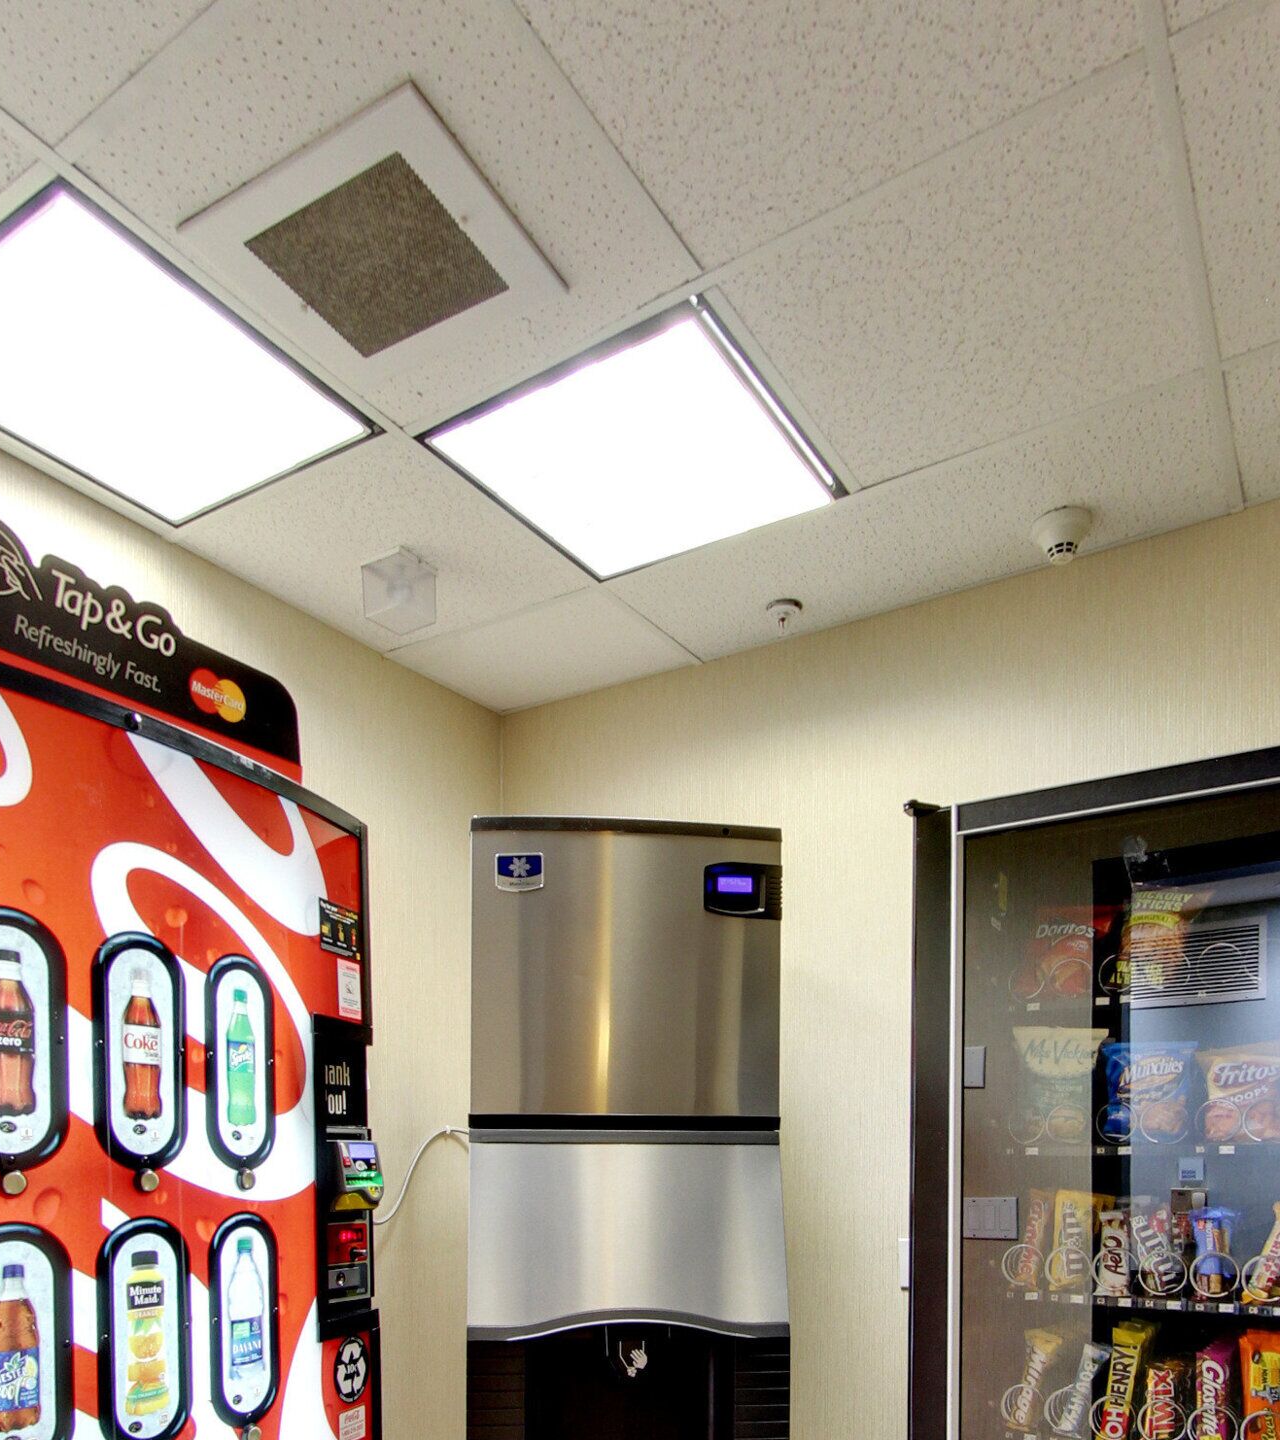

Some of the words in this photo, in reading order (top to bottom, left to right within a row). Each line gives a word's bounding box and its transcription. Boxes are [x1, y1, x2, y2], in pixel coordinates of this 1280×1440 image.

[50, 567, 178, 658] Tap&Go
[14, 613, 121, 681] Refreshingly
[124, 659, 162, 694] Fast.
[189, 677, 247, 714] MasterCard
[1035, 922, 1096, 938] Doritos
[124, 1032, 158, 1051] Coke
[325, 1061, 351, 1087] ank
[1119, 1058, 1184, 1087] Munchies
[1214, 1061, 1280, 1087] Fritos
[325, 1090, 347, 1116] ou!
[129, 1284, 162, 1297] Minute
[134, 1294, 158, 1306] Maid
[1013, 1348, 1047, 1425] Mirage
[1110, 1343, 1141, 1408] HENRY!
[1148, 1368, 1176, 1440] TWIX
[1201, 1359, 1224, 1437] Glosette
[1104, 1408, 1128, 1439] OH
